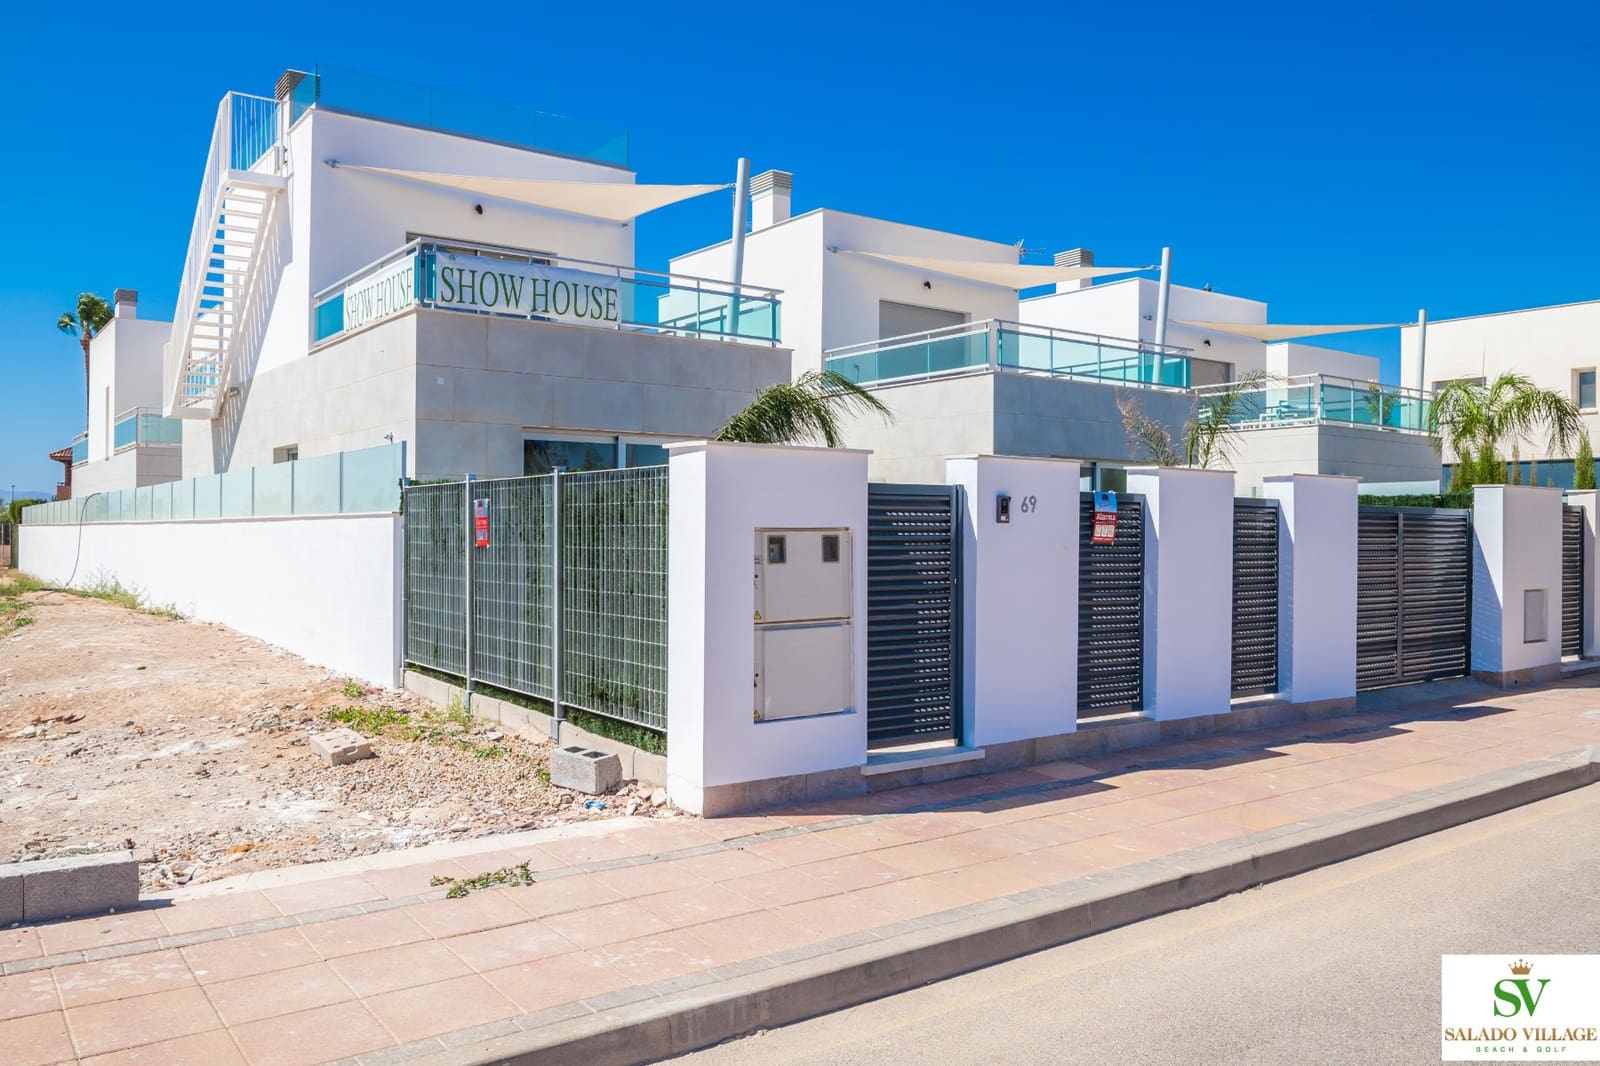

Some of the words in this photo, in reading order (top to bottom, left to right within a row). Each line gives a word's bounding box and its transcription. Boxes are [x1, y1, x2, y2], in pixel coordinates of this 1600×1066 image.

[345, 283, 374, 332] SHOW
[374, 267, 413, 321] HOUSE
[440, 266, 525, 309] SHOW
[531, 278, 618, 322] HOUSE
[1021, 495, 1037, 513] 69
